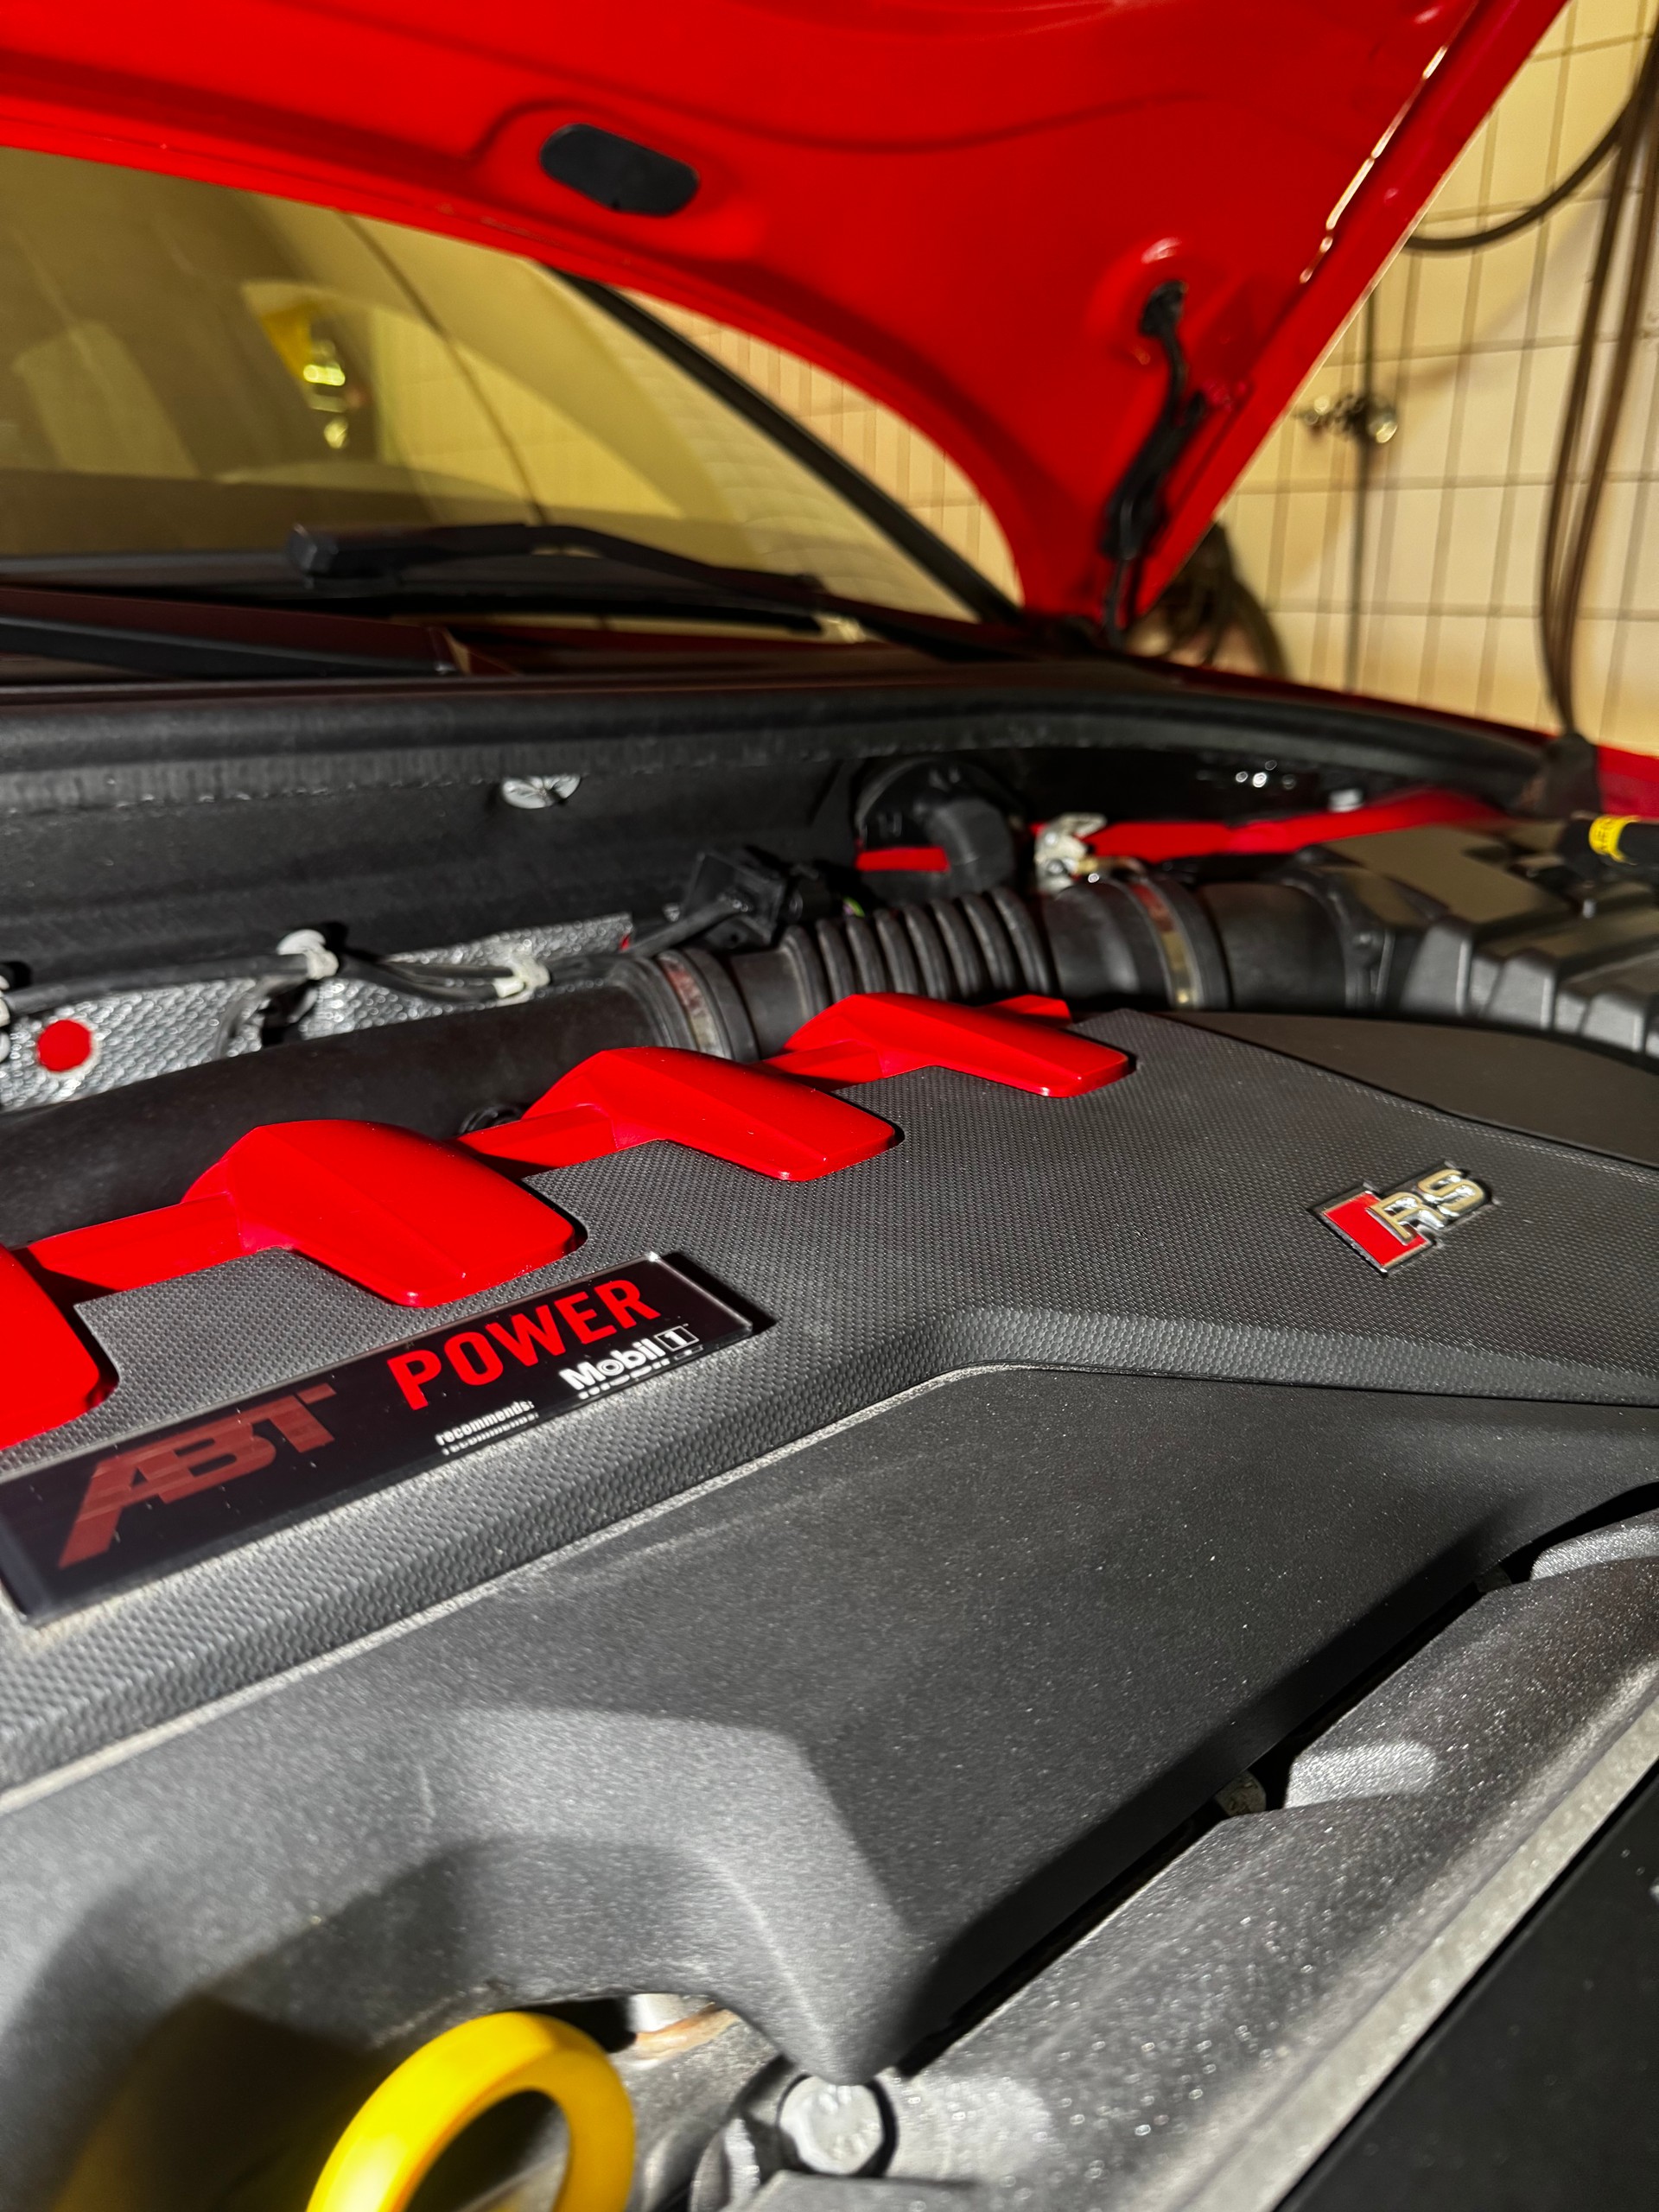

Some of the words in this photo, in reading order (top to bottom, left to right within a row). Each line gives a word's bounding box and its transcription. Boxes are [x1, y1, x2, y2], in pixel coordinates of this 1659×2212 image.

[1365, 1168, 1484, 1245] RS
[59, 1383, 337, 1569] ABT
[386, 1279, 660, 1410] POWER
[435, 1400, 536, 1446] recommends:
[558, 1338, 666, 1390] Mobil
